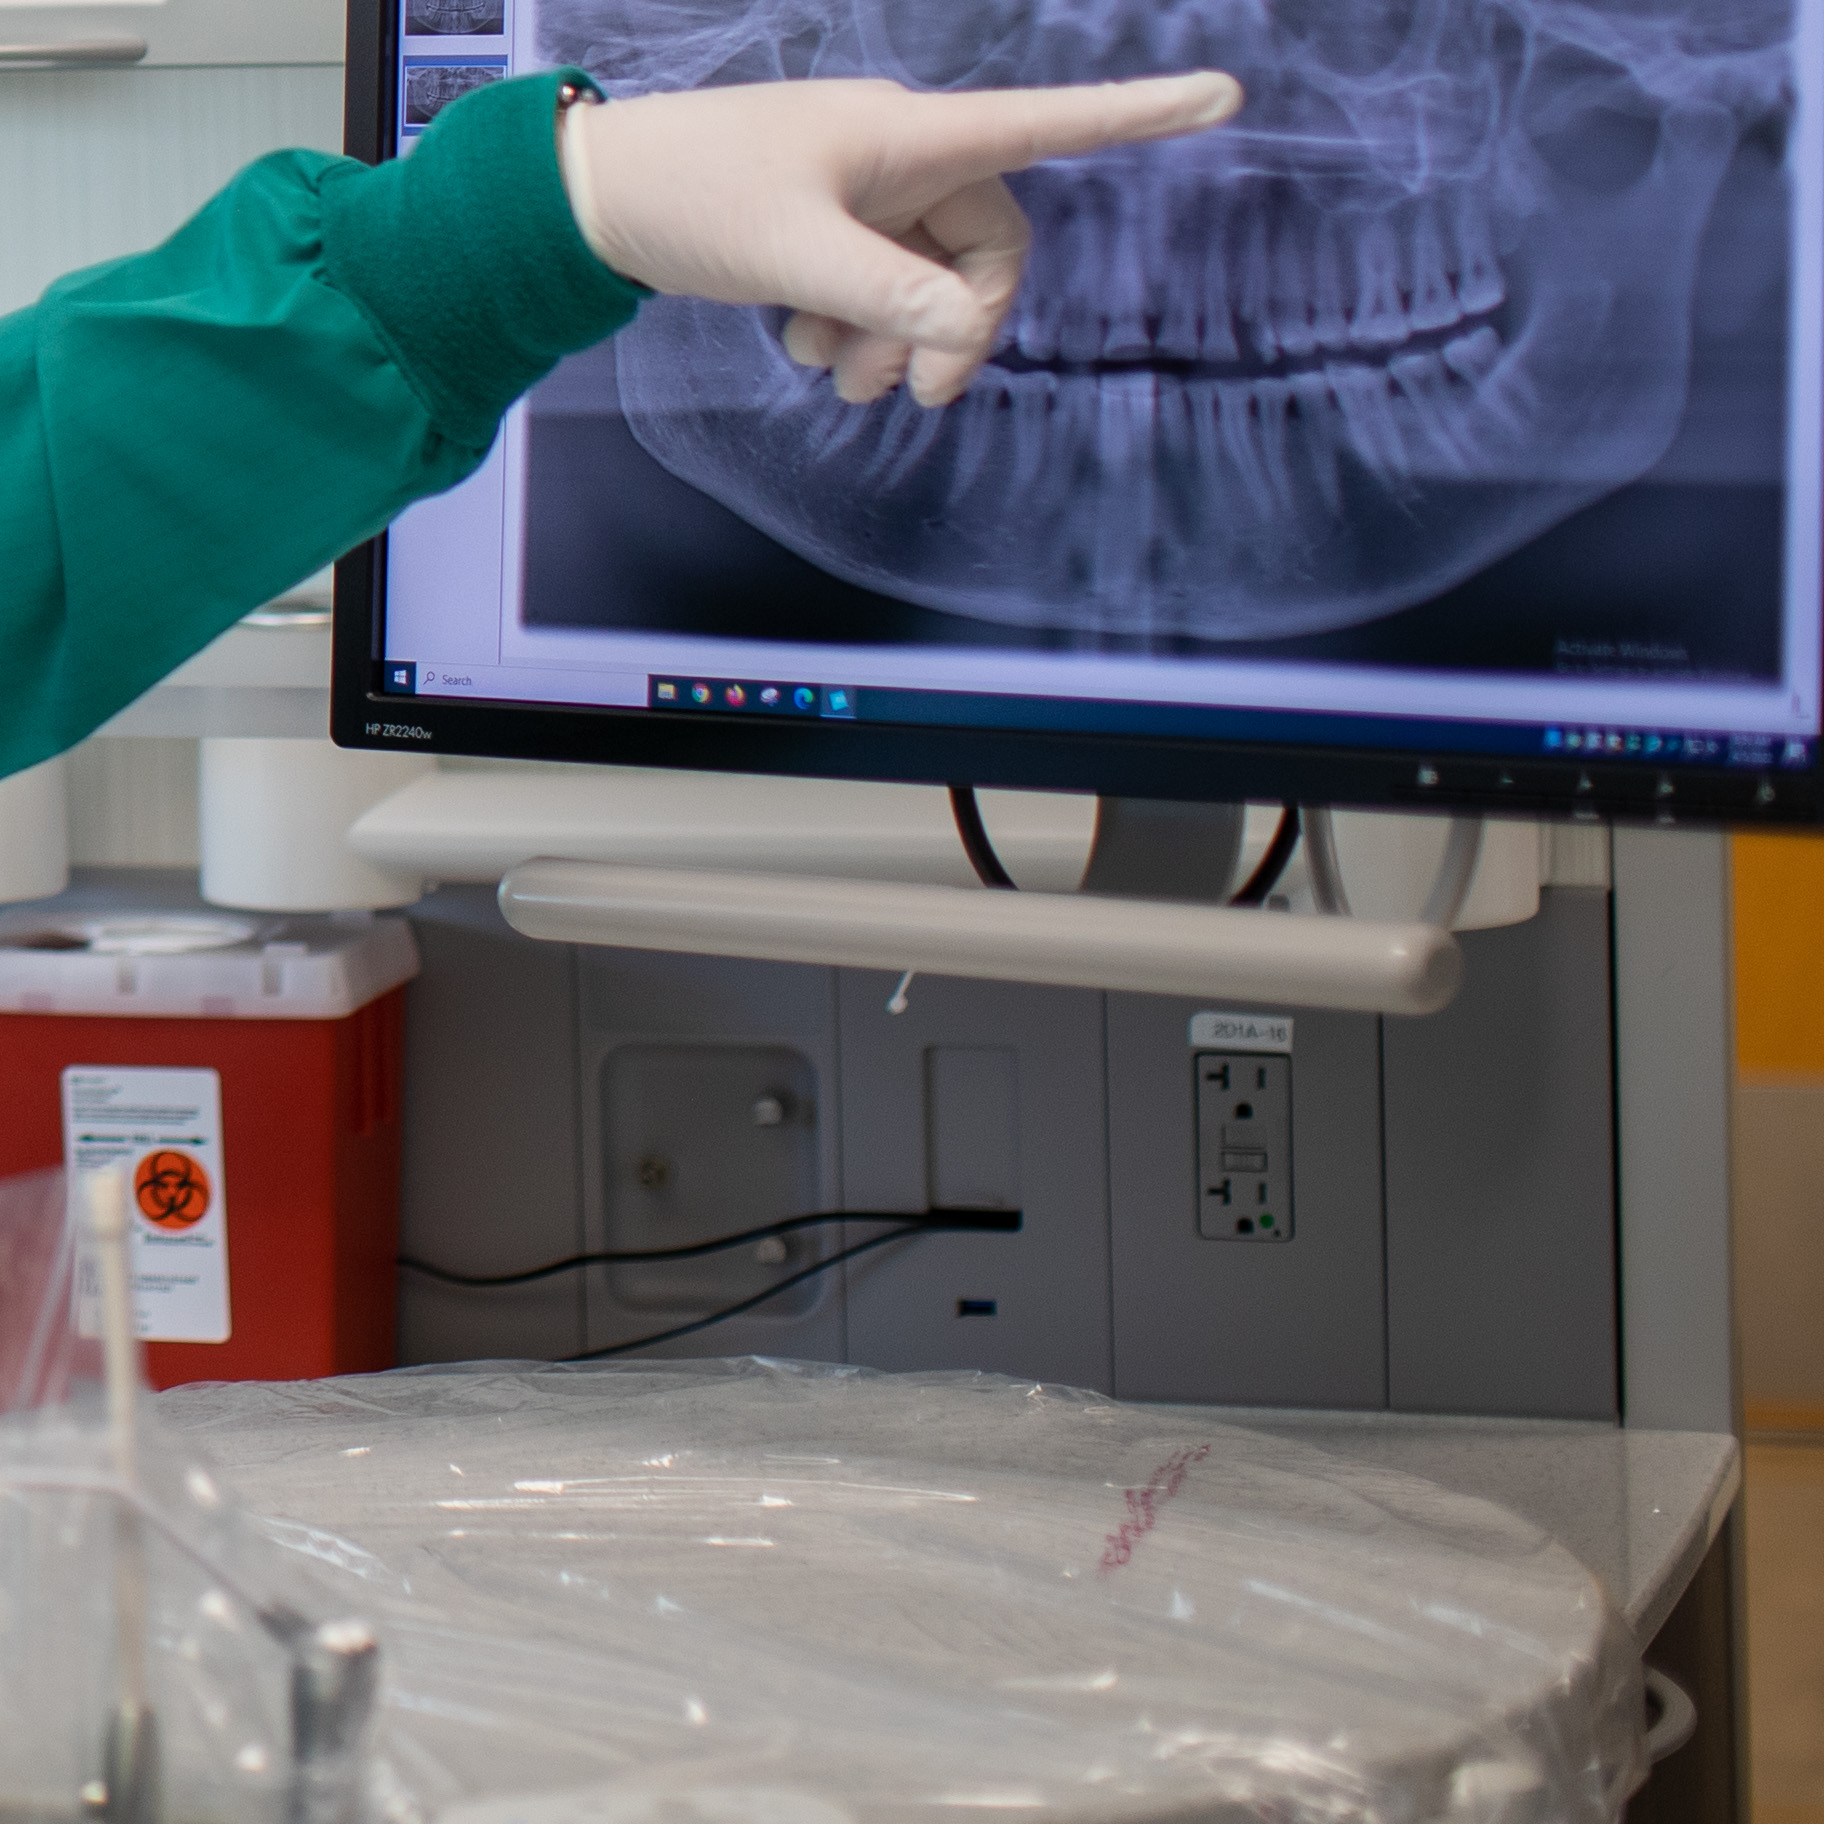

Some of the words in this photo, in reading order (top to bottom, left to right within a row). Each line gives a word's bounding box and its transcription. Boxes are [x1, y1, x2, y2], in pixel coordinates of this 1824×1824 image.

[442, 674, 472, 686] Search
[365, 722, 380, 735] HP
[382, 723, 433, 740] ZR2240w
